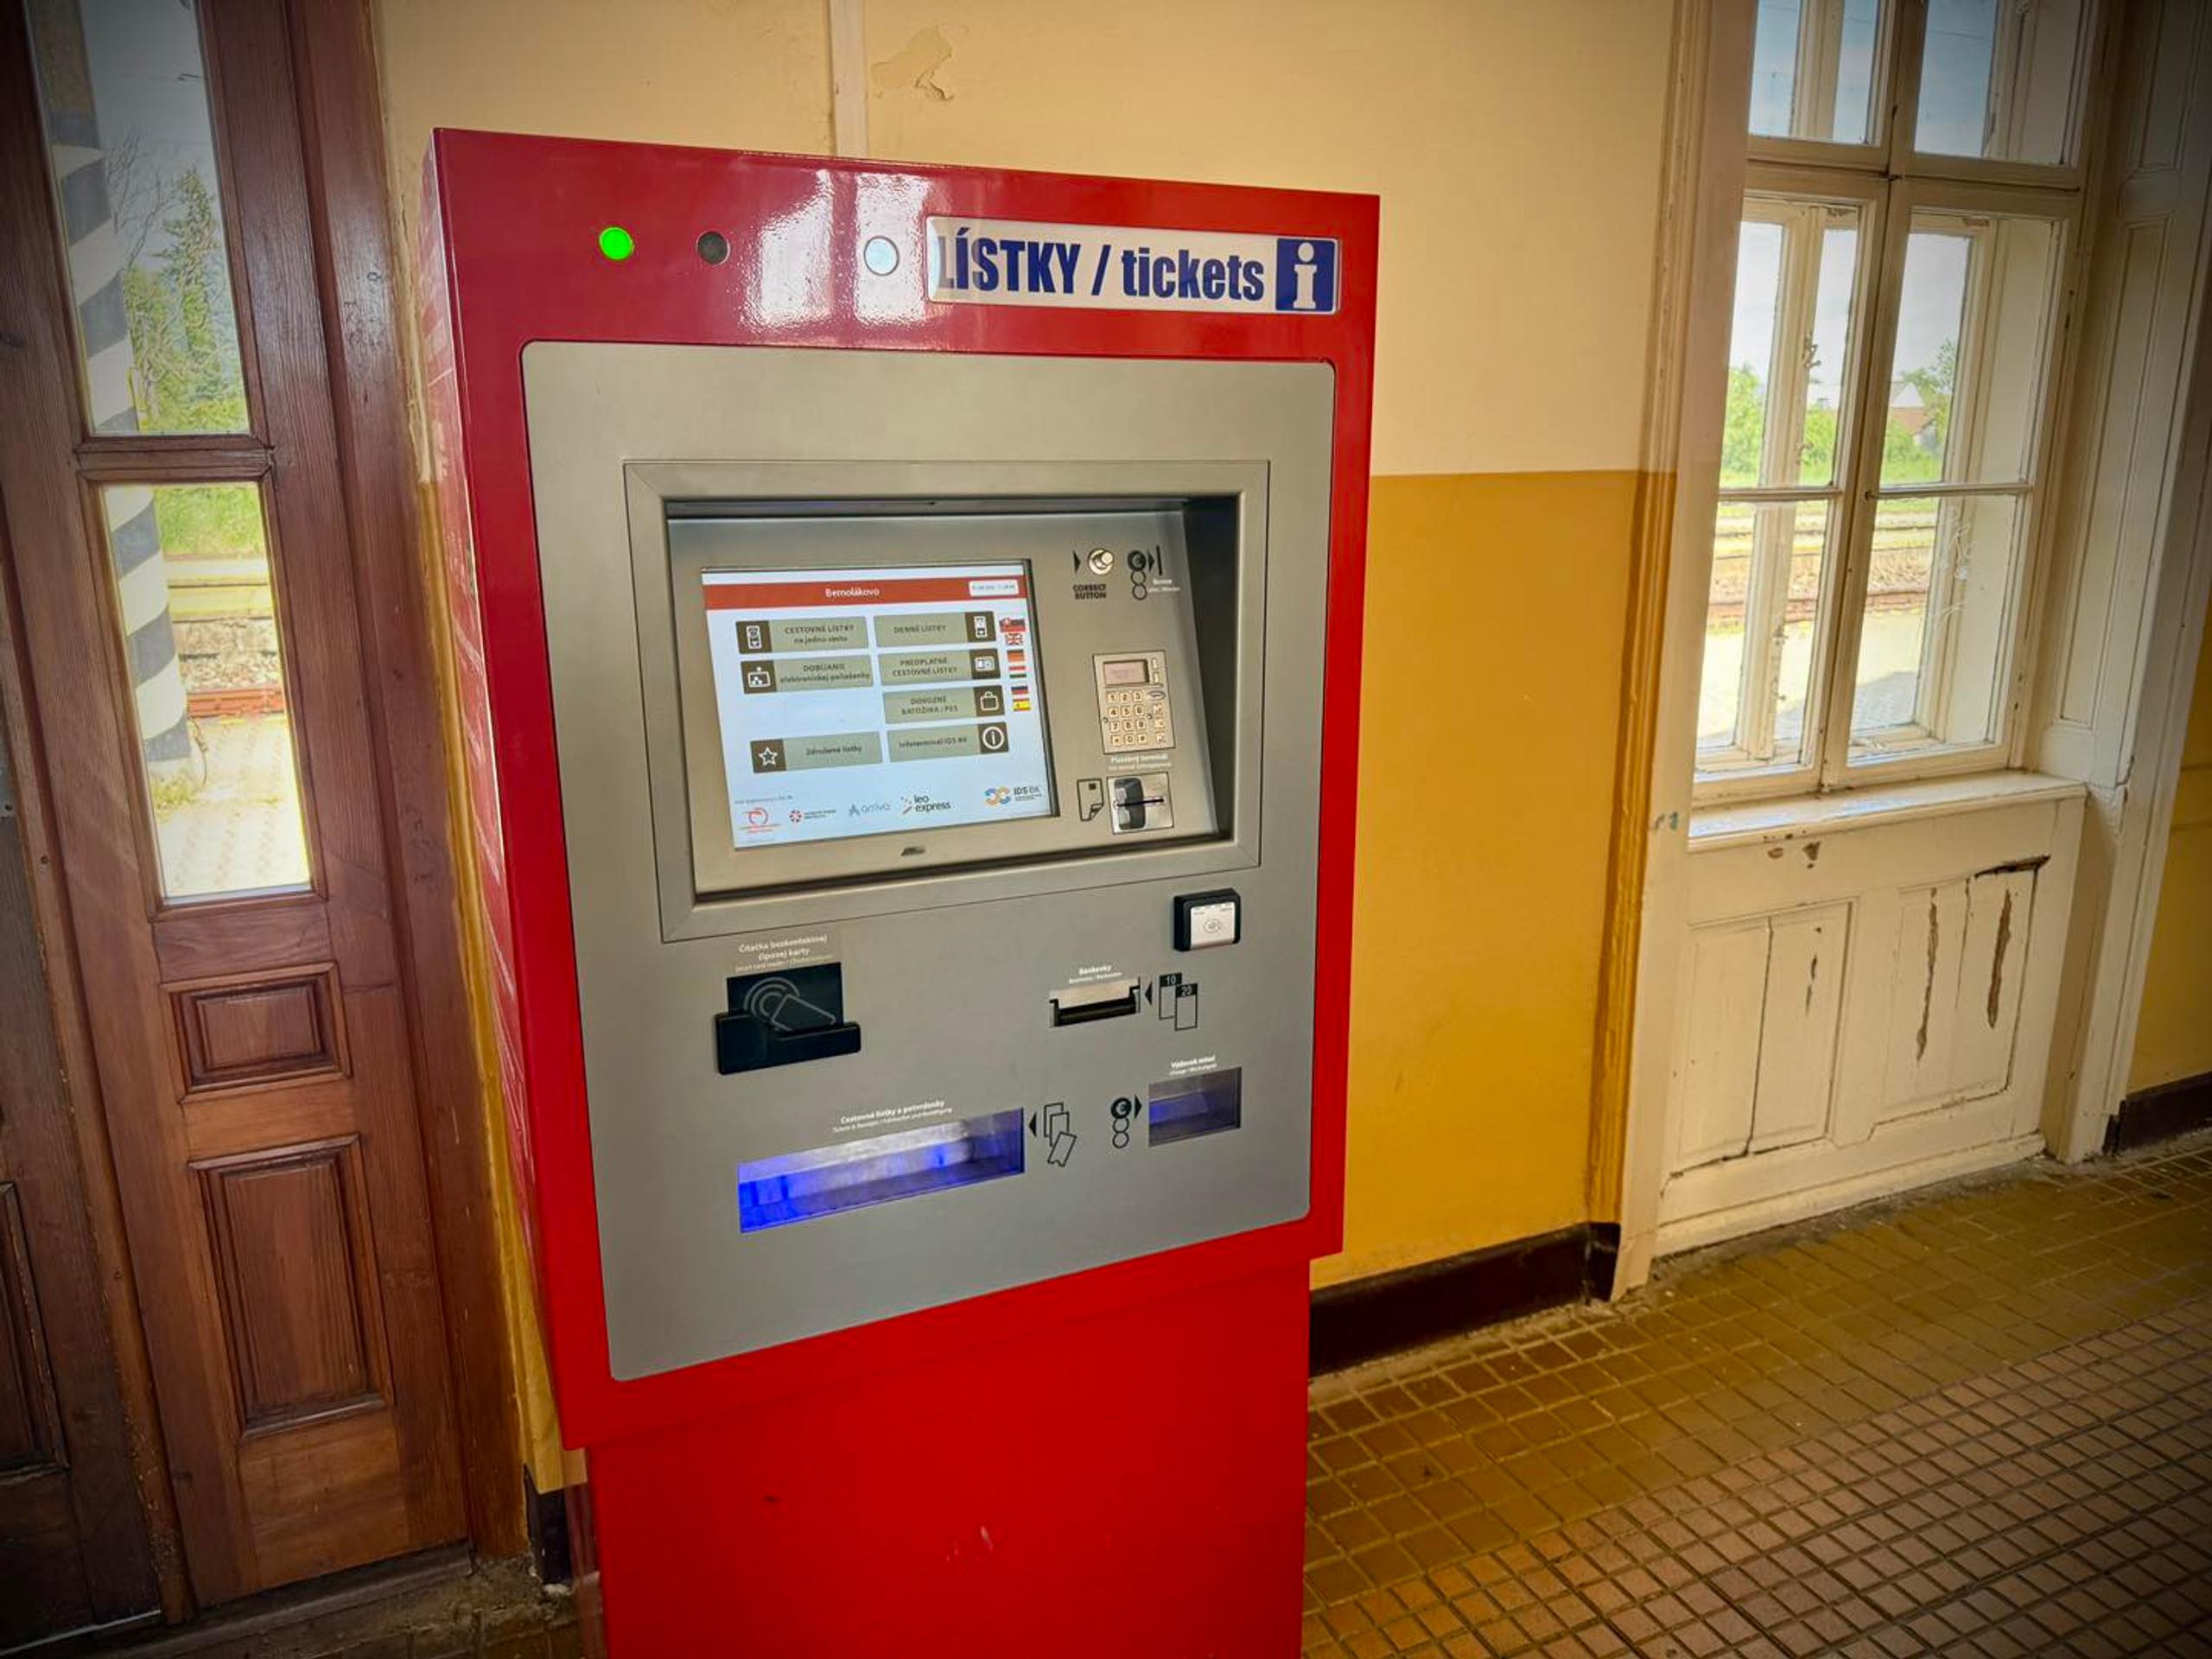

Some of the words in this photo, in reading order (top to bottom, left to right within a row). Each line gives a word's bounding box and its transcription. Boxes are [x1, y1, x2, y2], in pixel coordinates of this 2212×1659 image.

[938, 226, 1081, 296] LÍSTKY
[1091, 245, 1111, 296] /
[1121, 246, 1264, 302] tickets
[824, 588, 880, 598] Bernolákovo
[1075, 592, 1107, 601] BUTTON
[1014, 785, 1028, 796] IDS
[914, 795, 930, 804] leo
[915, 802, 951, 814] express
[1166, 976, 1176, 986] 10
[1180, 986, 1192, 996] 20
